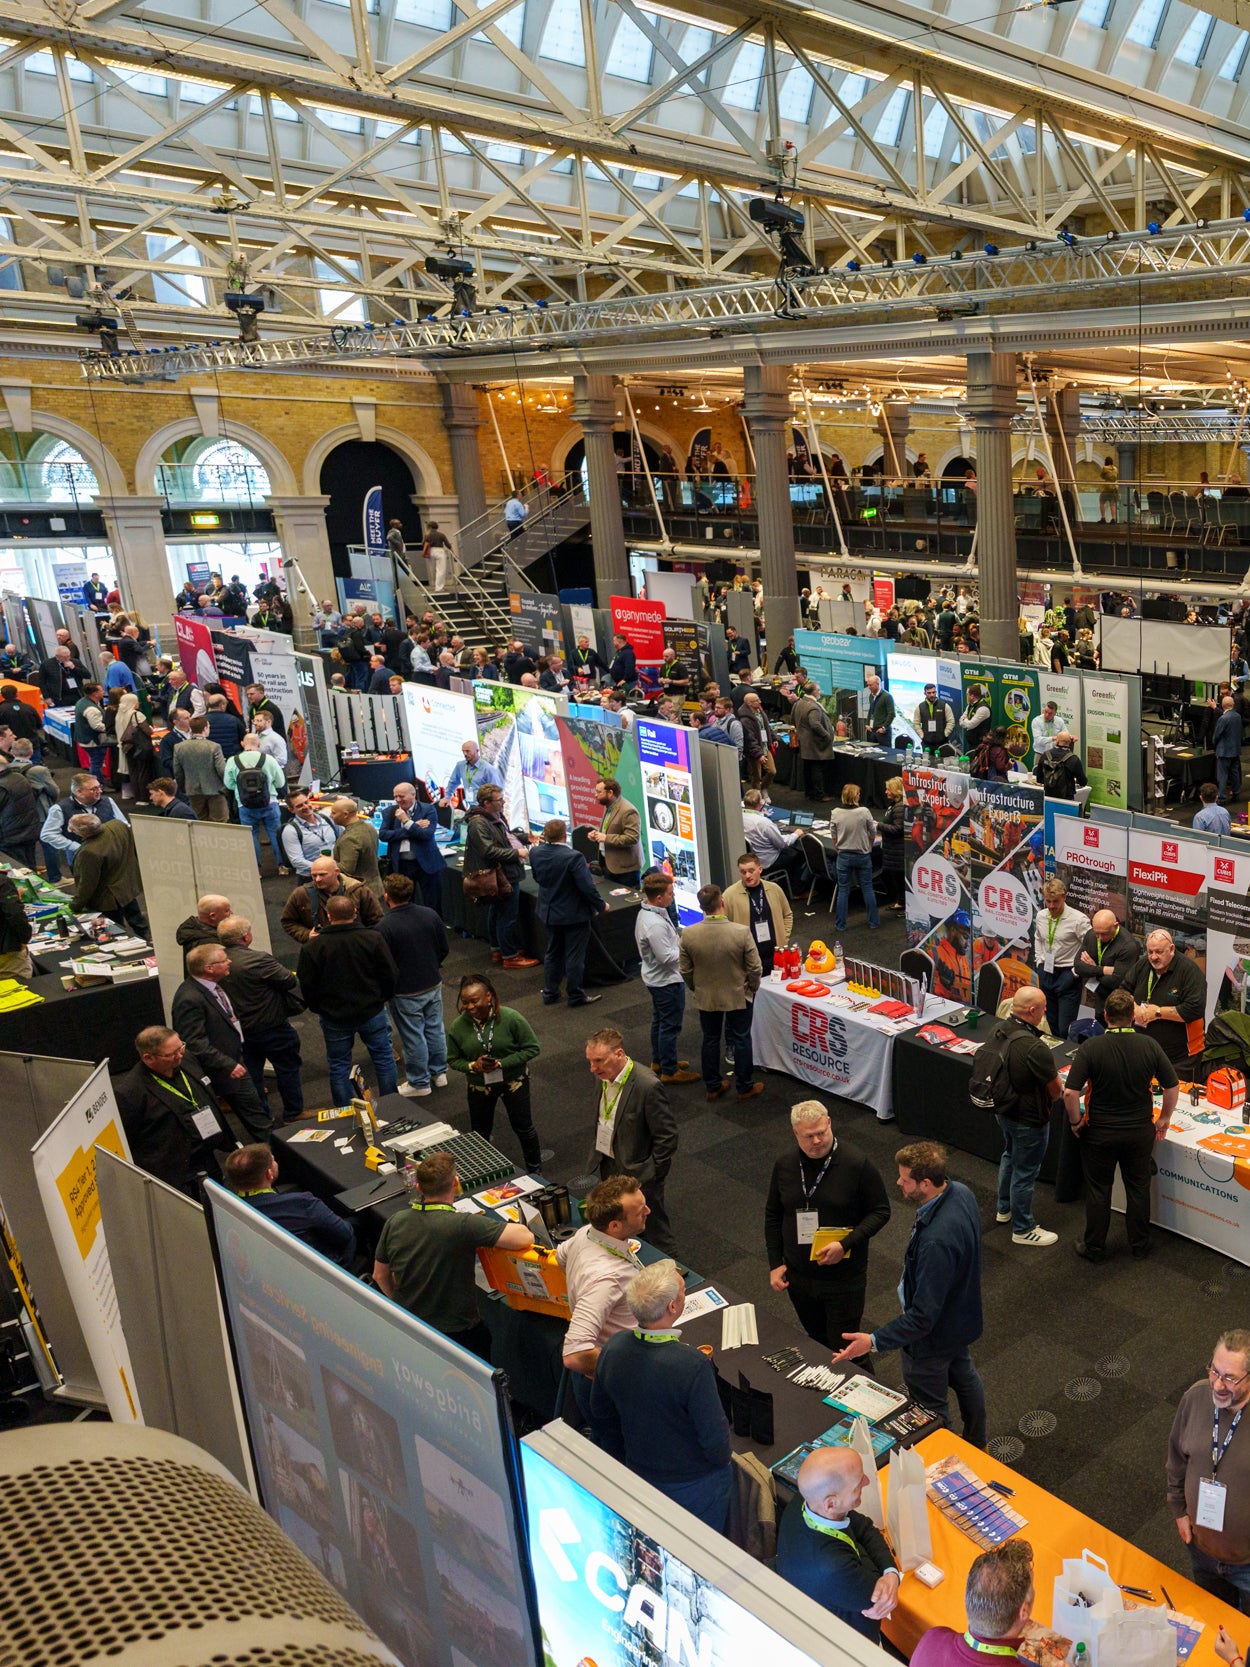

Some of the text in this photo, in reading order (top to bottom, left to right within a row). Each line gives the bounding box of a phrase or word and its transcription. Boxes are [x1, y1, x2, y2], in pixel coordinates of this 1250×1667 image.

[622, 610, 662, 623] ganymede
[821, 635, 851, 647] geobear
[265, 673, 279, 681] years
[1046, 684, 1070, 694] Greenfix
[1092, 689, 1117, 700] Greenfix
[1087, 708, 1121, 719] EROSION CONTROL
[647, 729, 656, 738] Rail
[572, 775, 590, 784] leading
[908, 773, 962, 795] Infrastructure
[570, 784, 589, 794] provider
[572, 794, 596, 804] temporary
[920, 789, 950, 807] Experts
[975, 788, 1035, 810] Infrastructure
[988, 805, 1020, 824] Experts
[1067, 852, 1115, 872] PROtrough
[1133, 868, 1168, 884] FlexiPit
[1217, 868, 1232, 876] CUBIS
[917, 866, 957, 897] CRS
[1095, 881, 1107, 889] most
[1070, 884, 1108, 897] flame-retardant
[1133, 888, 1190, 905] Lightweight trackside
[984, 884, 1028, 917] CRS
[1066, 892, 1109, 906] non-cementitious
[1079, 902, 1095, 910] trough
[1132, 896, 1198, 915] drainage chambers that
[1210, 896, 1225, 906] Fixed
[1132, 904, 1149, 912] install
[1162, 910, 1184, 920] minutes
[791, 1002, 848, 1058] CRS
[793, 1042, 850, 1075] RESOURCE
[793, 1057, 850, 1084] crs-resource.co.uk
[92, 1092, 108, 1115] BENDER
[1160, 1167, 1239, 1203] COMMUNICATIONS
[75, 1182, 96, 1219] Approved
